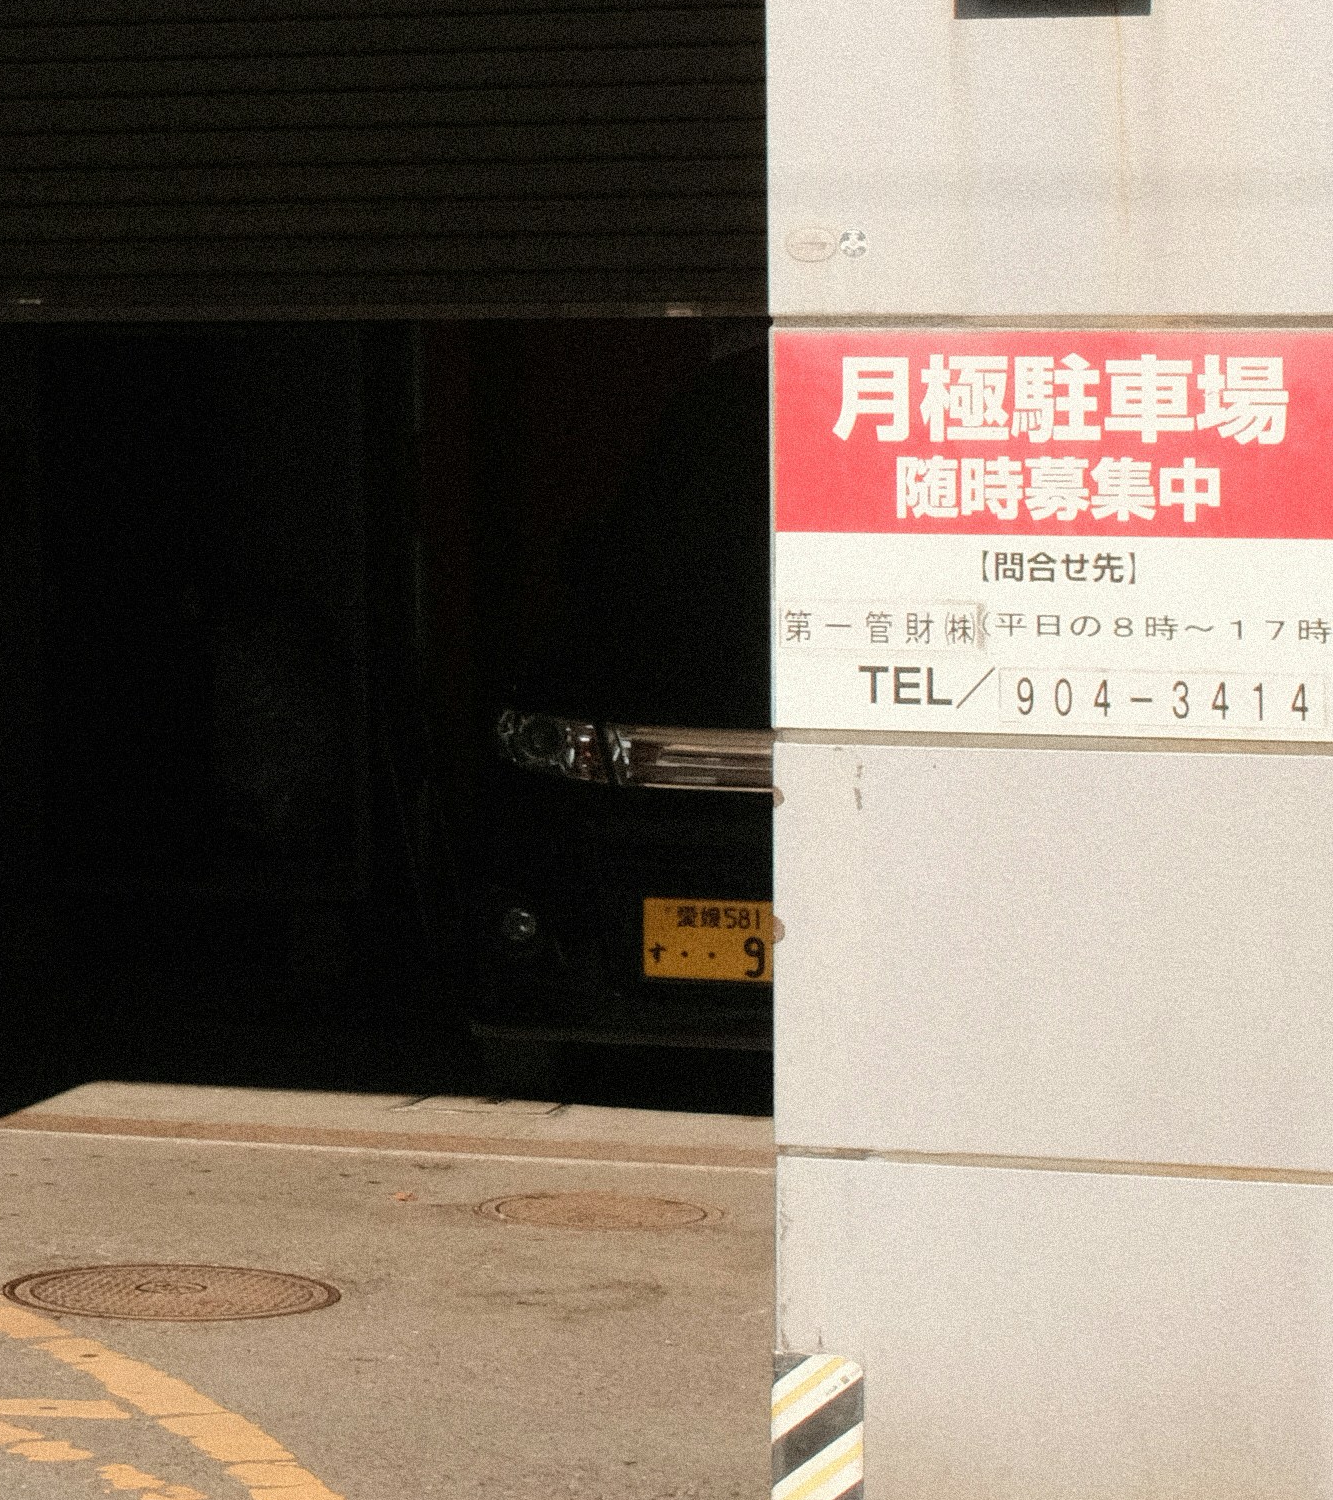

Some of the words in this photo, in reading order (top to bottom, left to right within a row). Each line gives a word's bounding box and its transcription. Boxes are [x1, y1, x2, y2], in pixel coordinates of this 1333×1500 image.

[833, 353, 1290, 445] 月極駐車場
[895, 455, 1222, 523] 随時募集中
[981, 549, 1137, 586] 【問合せ先】
